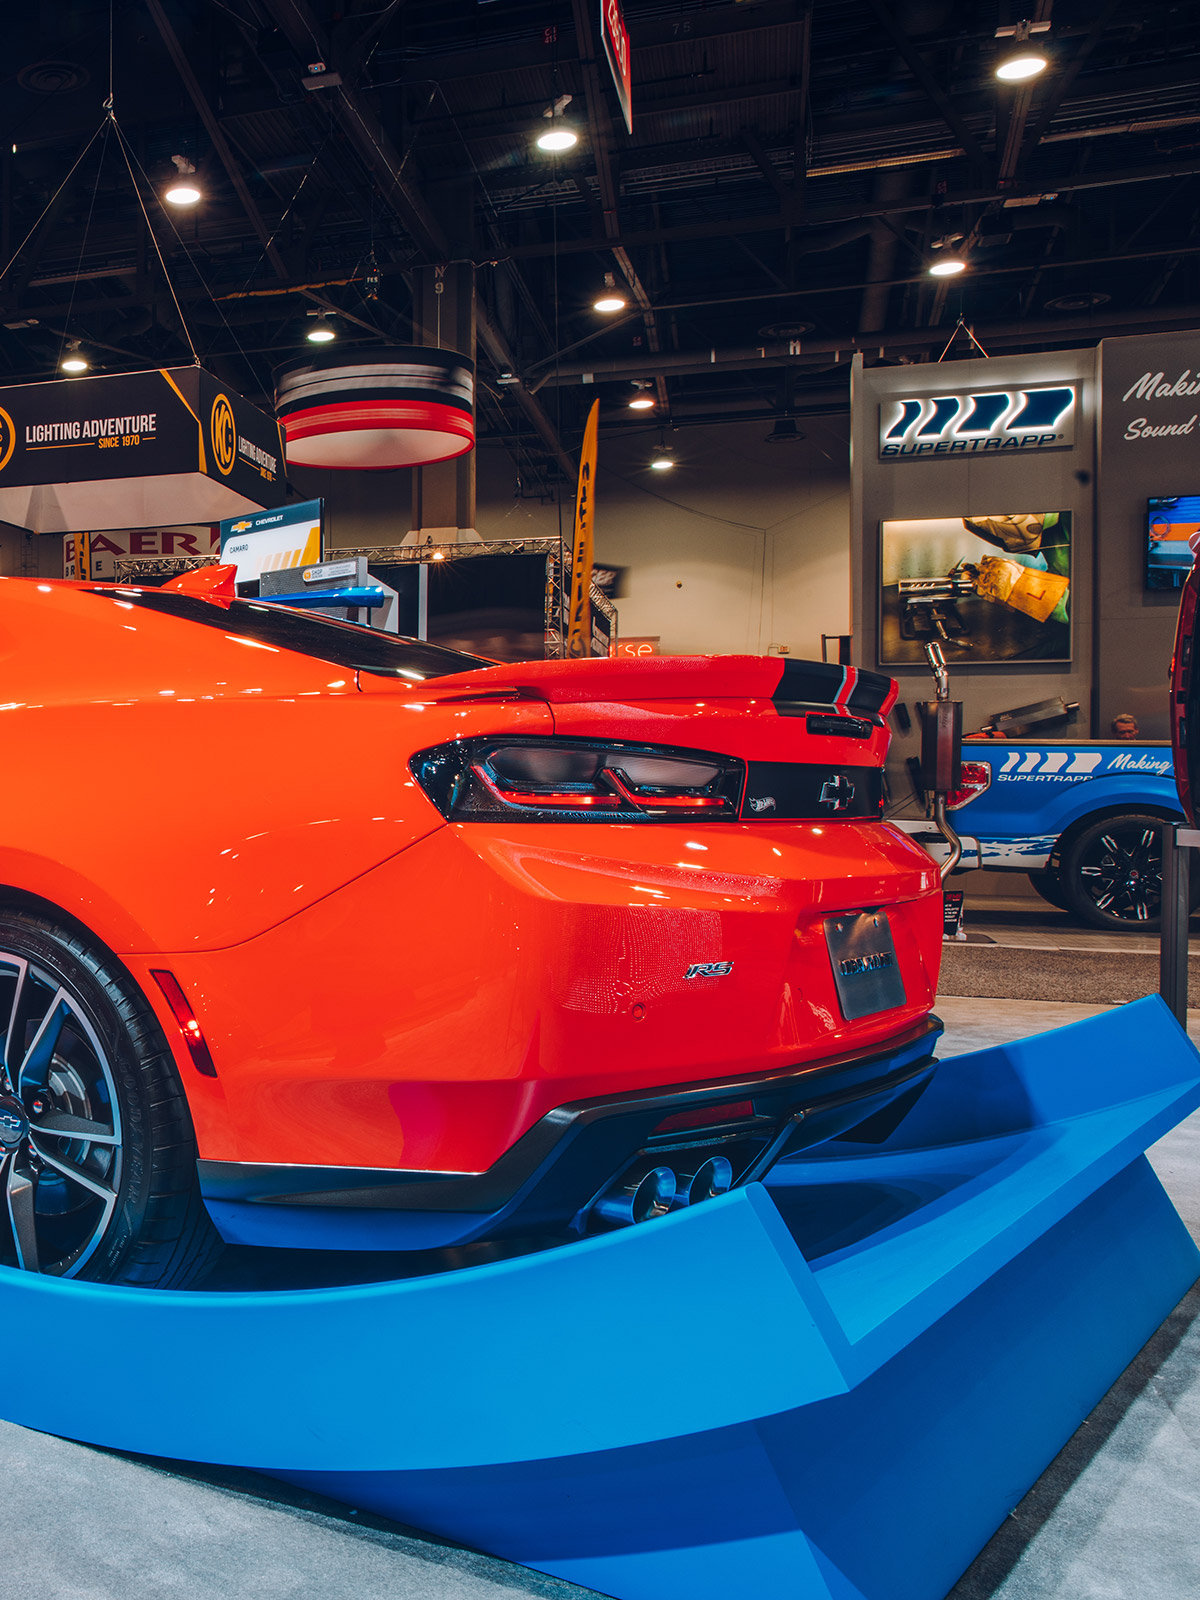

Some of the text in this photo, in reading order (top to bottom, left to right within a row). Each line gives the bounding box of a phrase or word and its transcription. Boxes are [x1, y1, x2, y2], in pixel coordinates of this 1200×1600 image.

[25, 413, 157, 443] LIGHTING ADVENTURE
[215, 403, 232, 465] KC
[1123, 414, 1198, 440] Sound
[98, 434, 141, 449] SINCE 1970
[881, 433, 1057, 456] SUPERTRAPP
[255, 514, 284, 527] CHEVROLET
[229, 543, 249, 554] CAMARO
[1107, 752, 1173, 776] Making
[682, 961, 734, 979] RS
